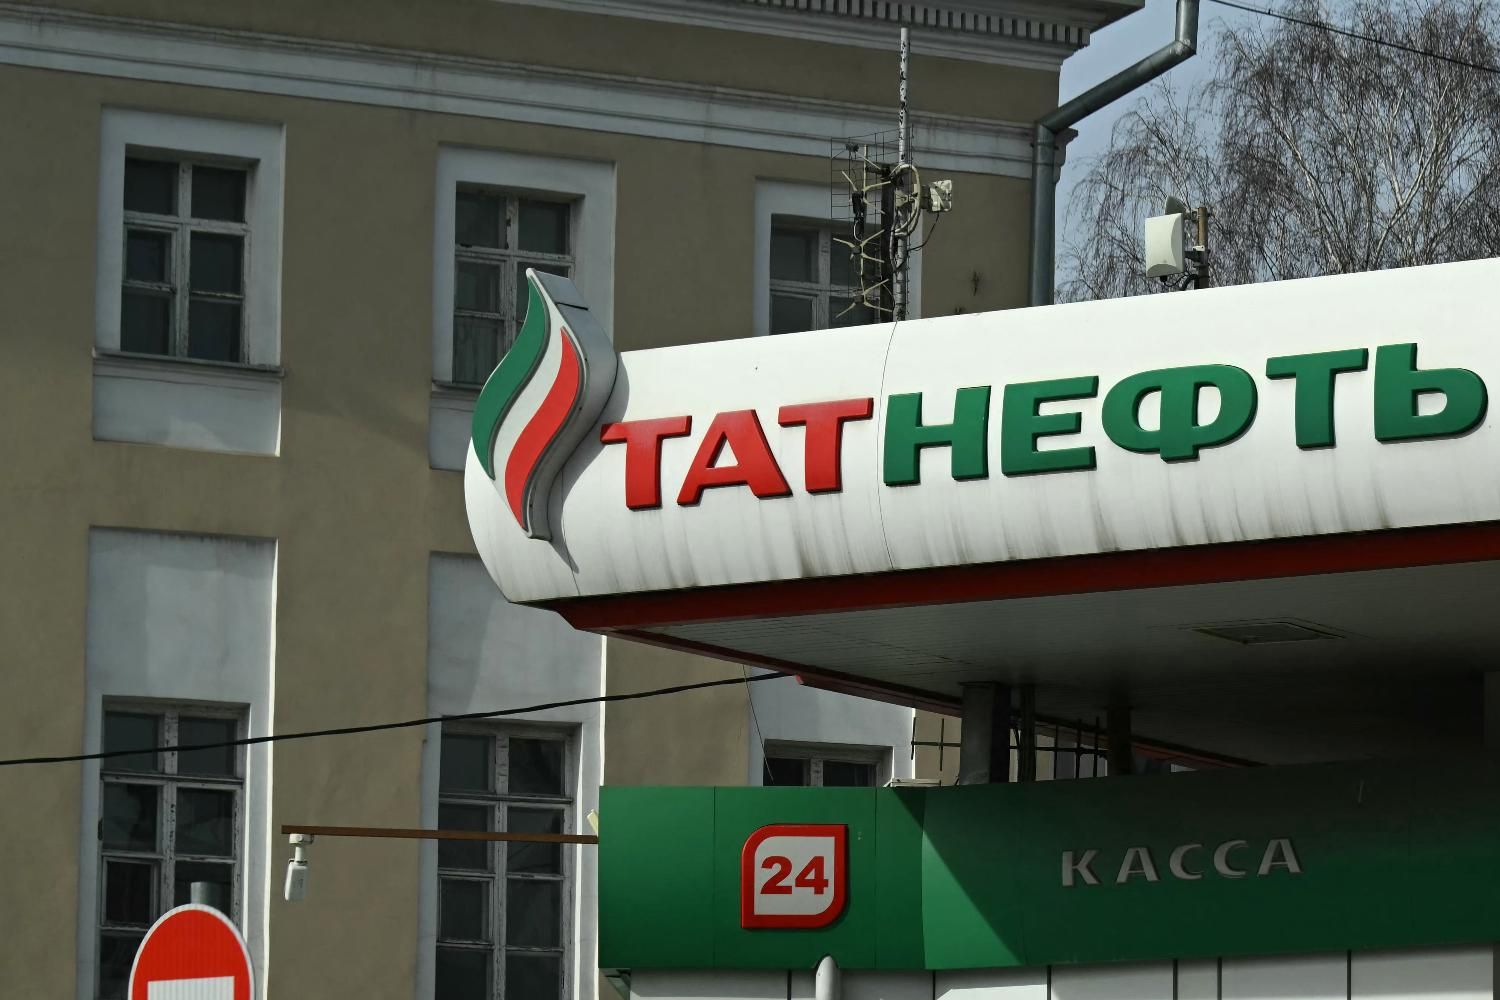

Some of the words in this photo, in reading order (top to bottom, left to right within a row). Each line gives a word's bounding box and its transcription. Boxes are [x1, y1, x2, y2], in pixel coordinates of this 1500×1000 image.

[602, 342, 1488, 511] ТАТНЕФТЬ
[759, 855, 829, 896] 24
[1060, 838, 1303, 887] КАССА
